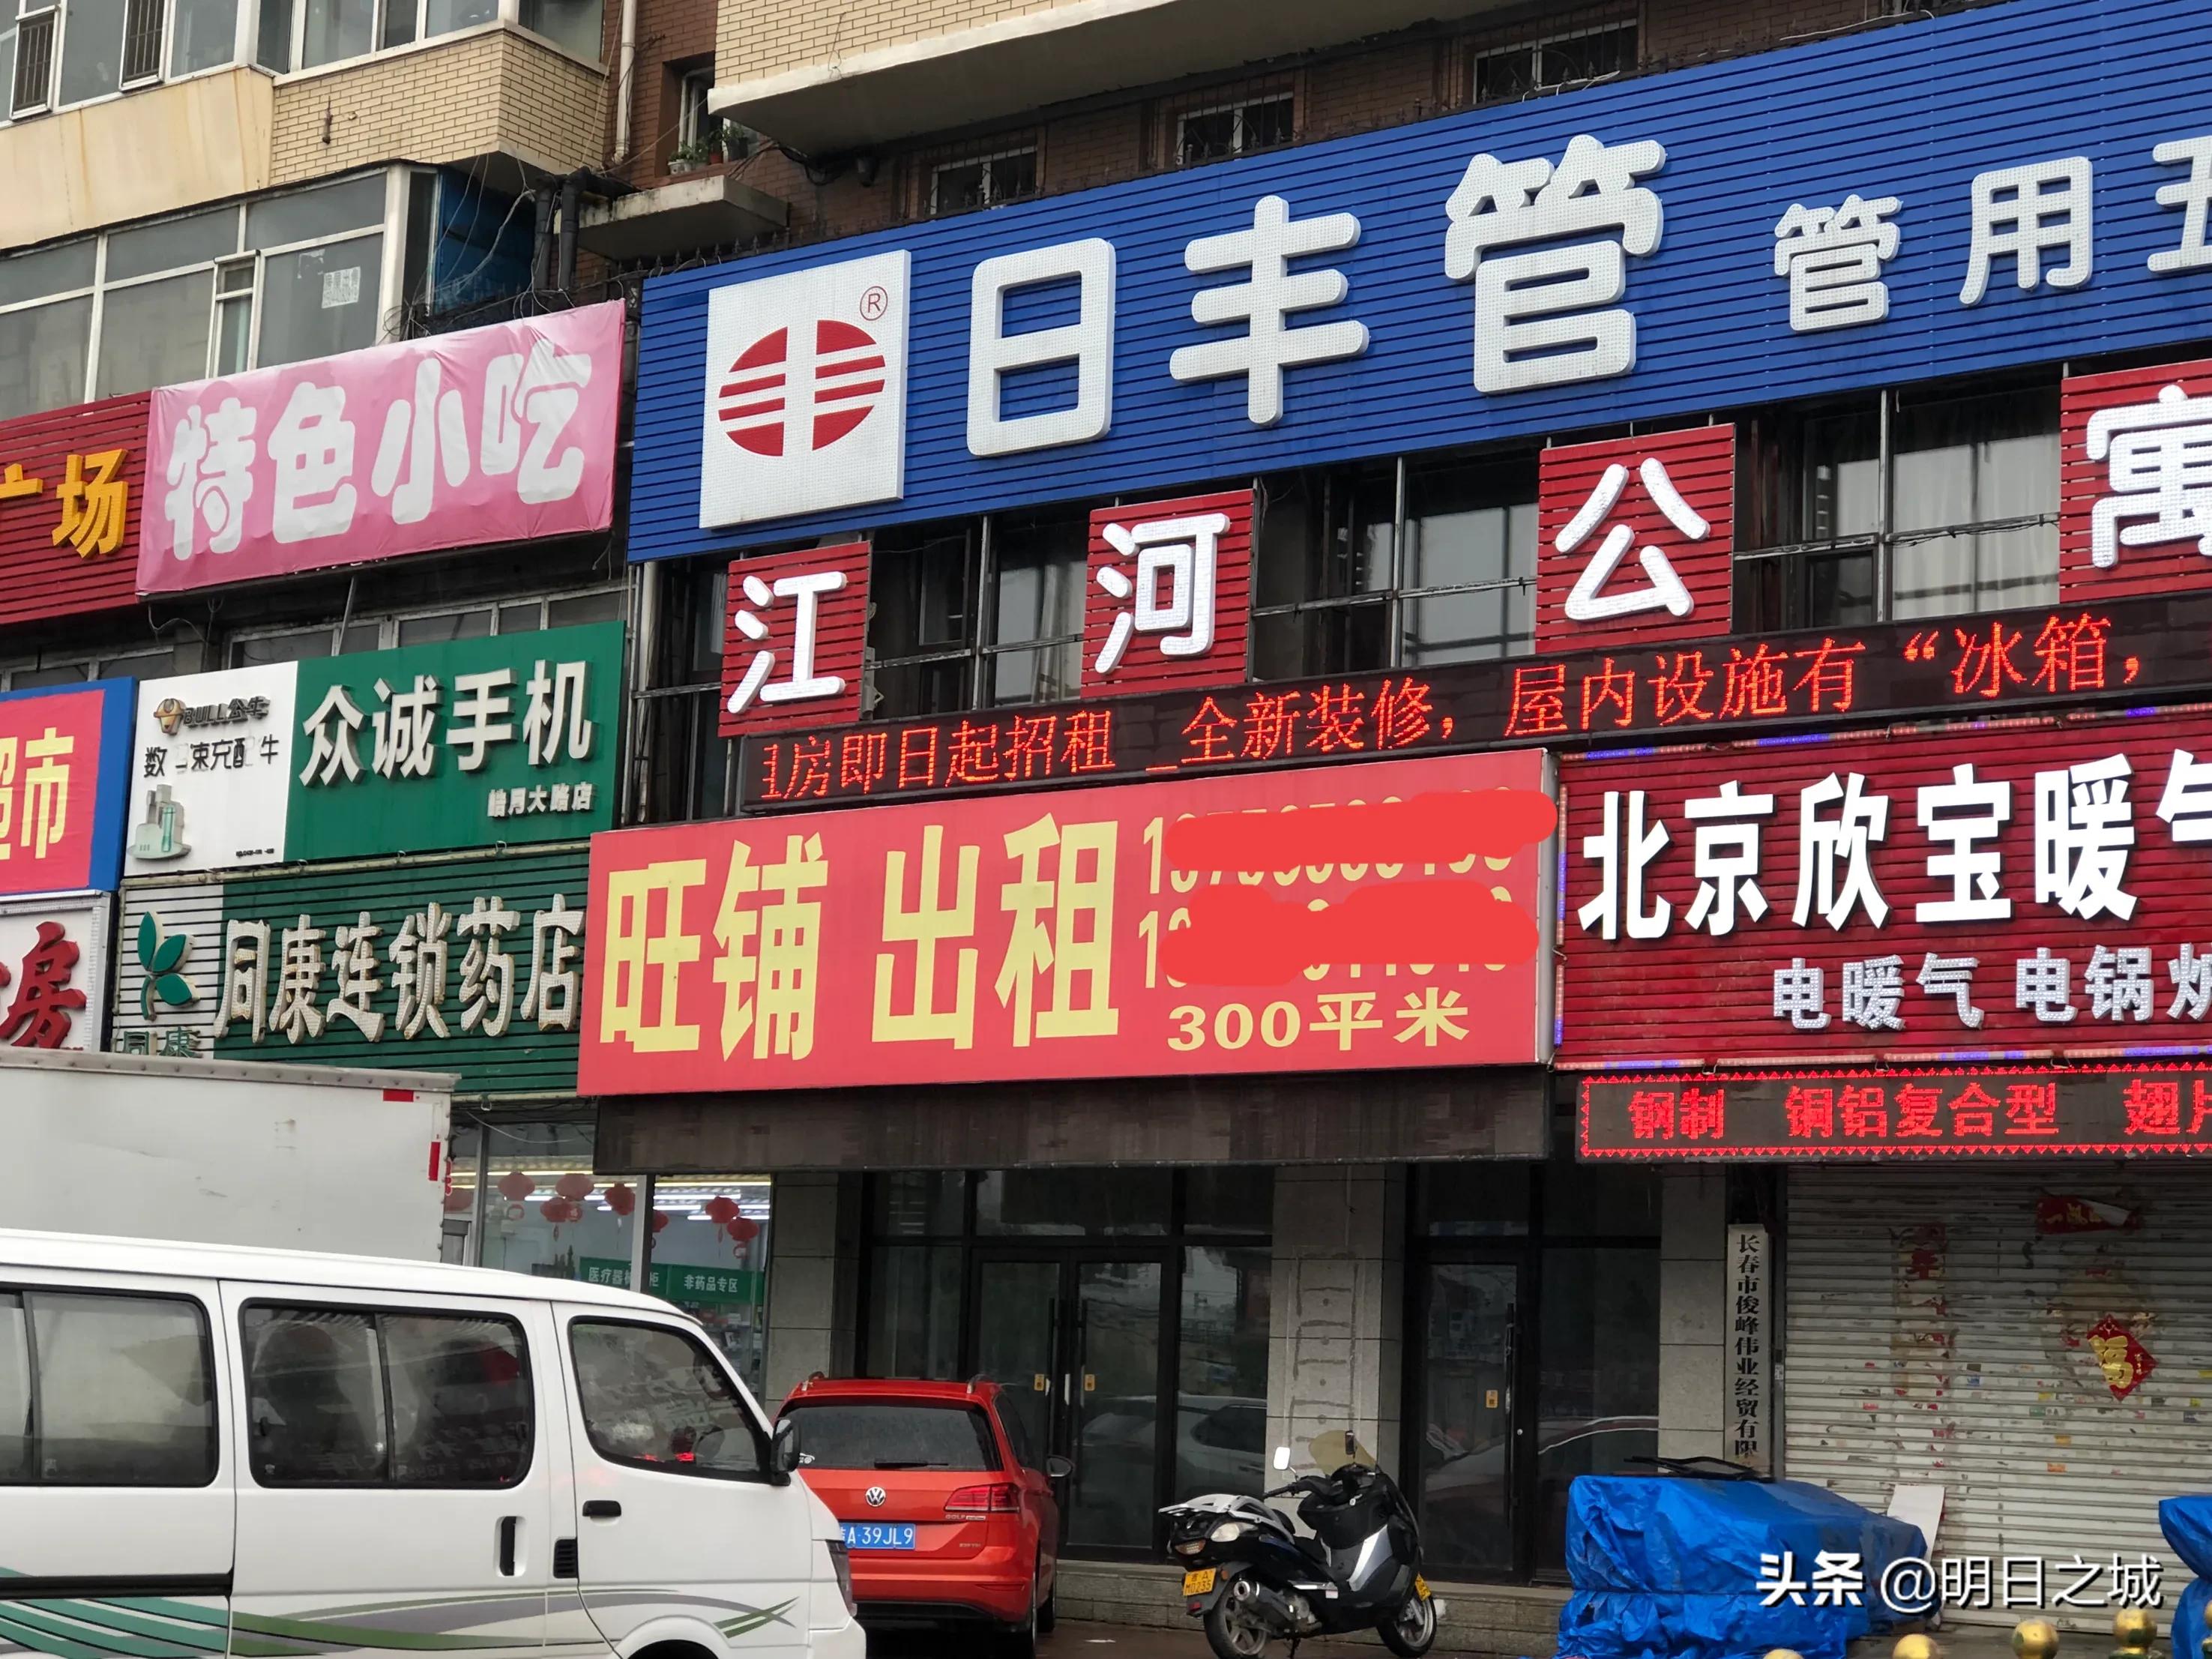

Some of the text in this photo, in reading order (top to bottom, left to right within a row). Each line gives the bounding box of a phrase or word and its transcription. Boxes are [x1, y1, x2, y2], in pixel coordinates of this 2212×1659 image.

[968, 135, 1667, 457] 日丰管
[165, 338, 592, 560] 特色小吃
[300, 660, 593, 786] 众诚手机
[214, 894, 587, 1044] 同康连锁药店
[599, 832, 828, 1062] 旺铺
[873, 813, 1119, 1050] 出租
[1773, 953, 1985, 1031] 电暖气
[1167, 987, 1470, 1051] 300平米
[1627, 1087, 1726, 1139] 钢制
[684, 1274, 738, 1293] 非药品专区
